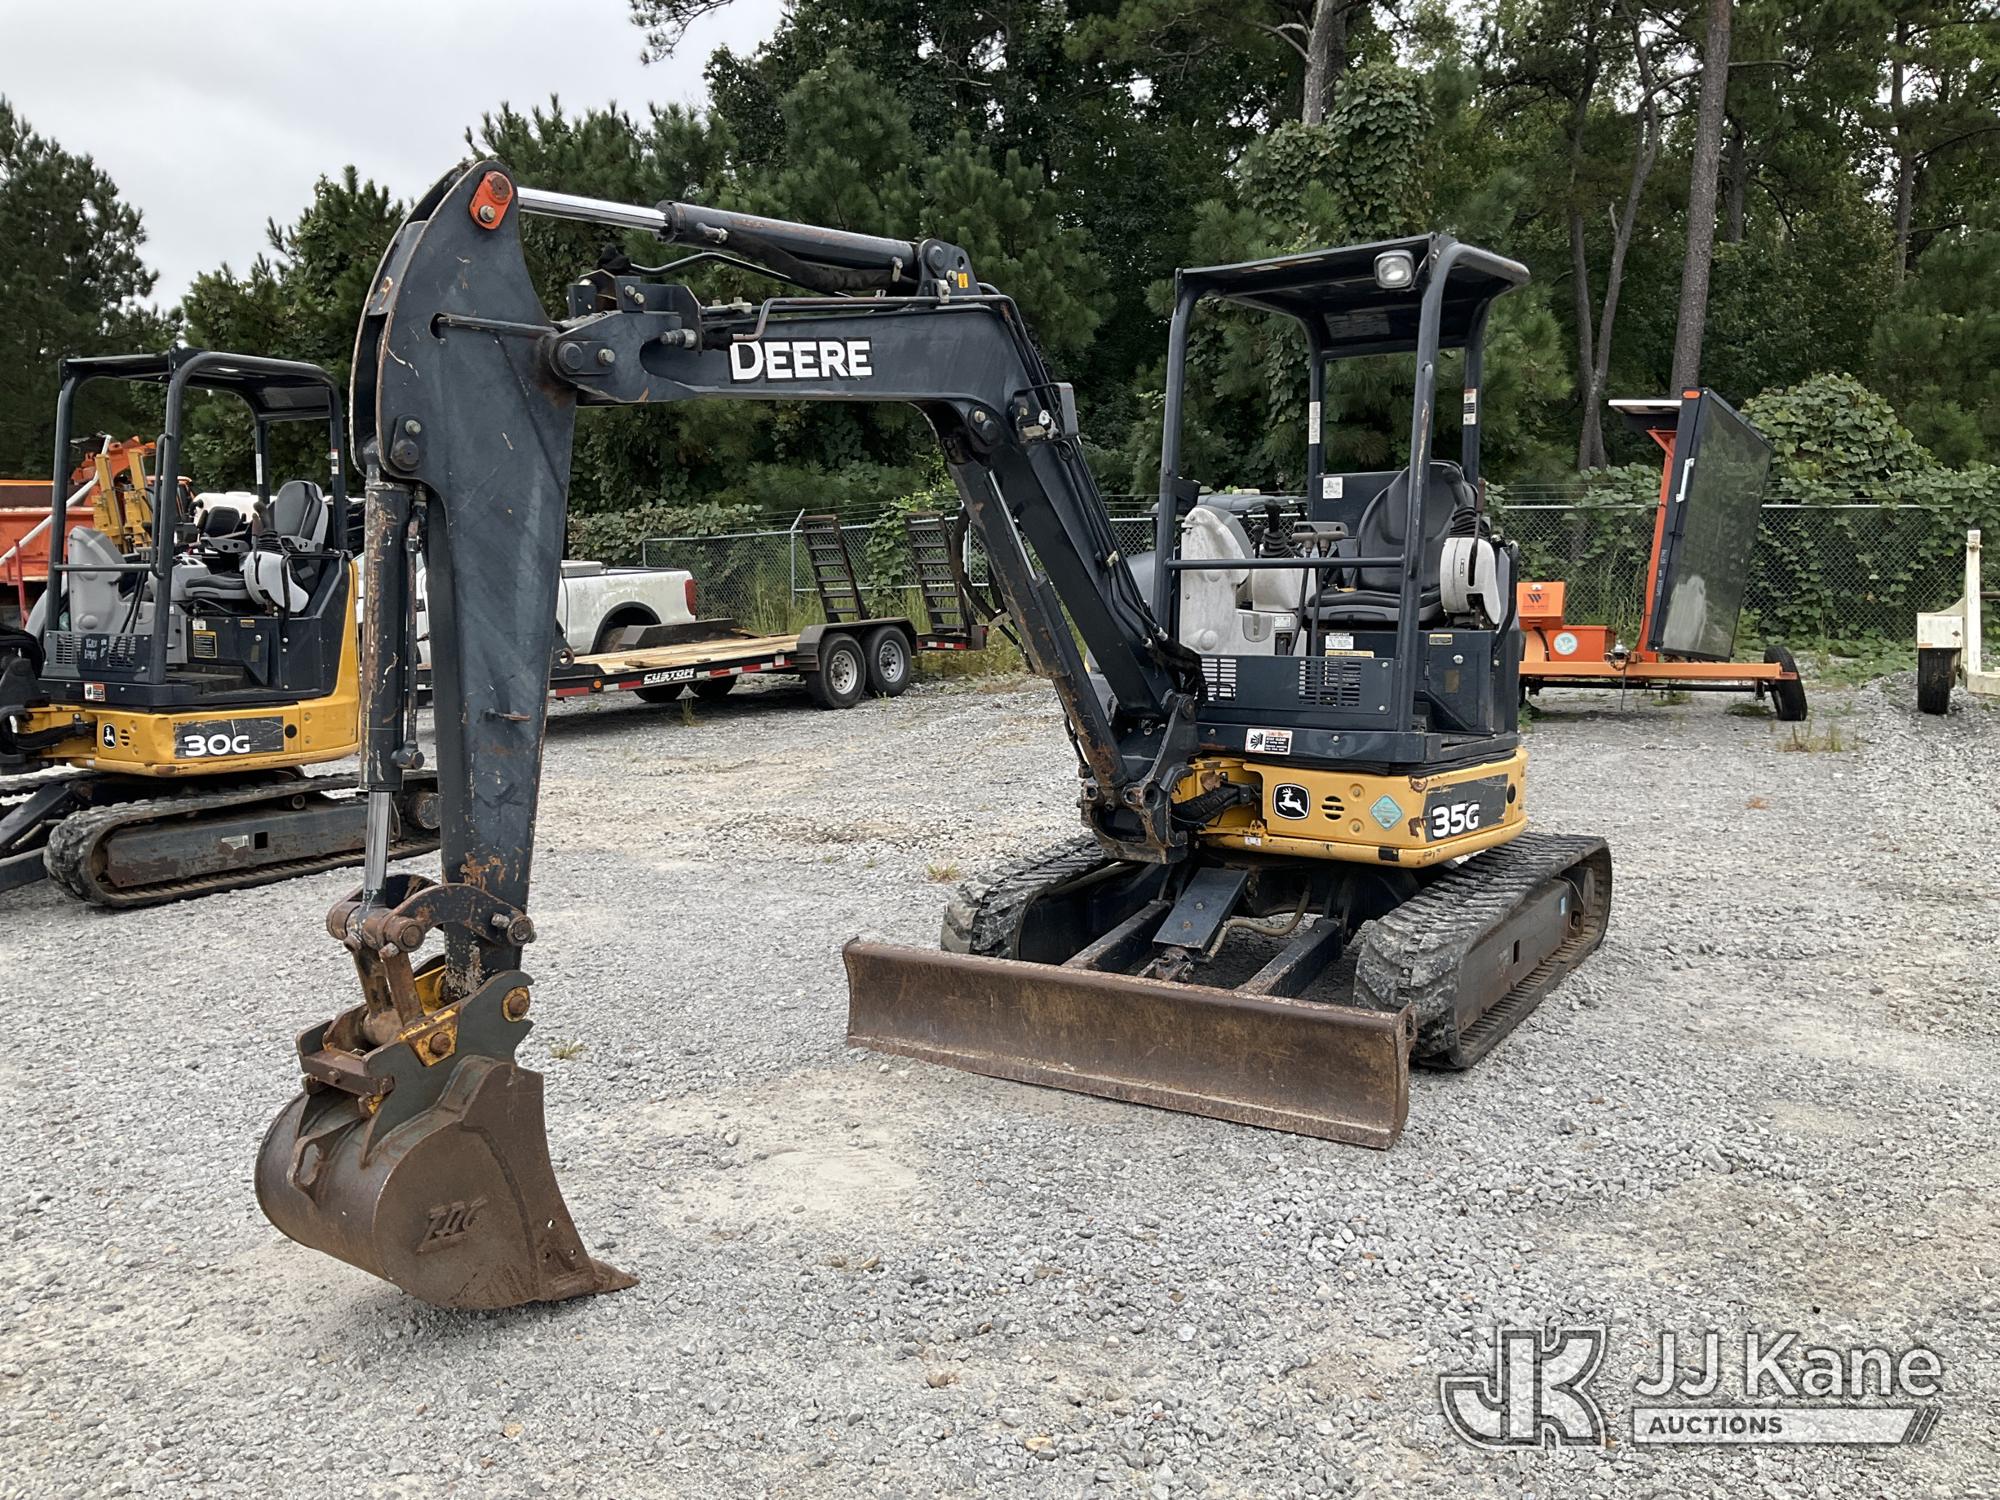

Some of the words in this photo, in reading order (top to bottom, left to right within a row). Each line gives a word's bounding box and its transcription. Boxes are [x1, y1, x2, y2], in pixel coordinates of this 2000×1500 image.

[730, 340, 873, 380] DEERE
[643, 668, 695, 682] CUSTOM
[184, 733, 251, 757] 30G
[1432, 803, 1480, 838] 35G
